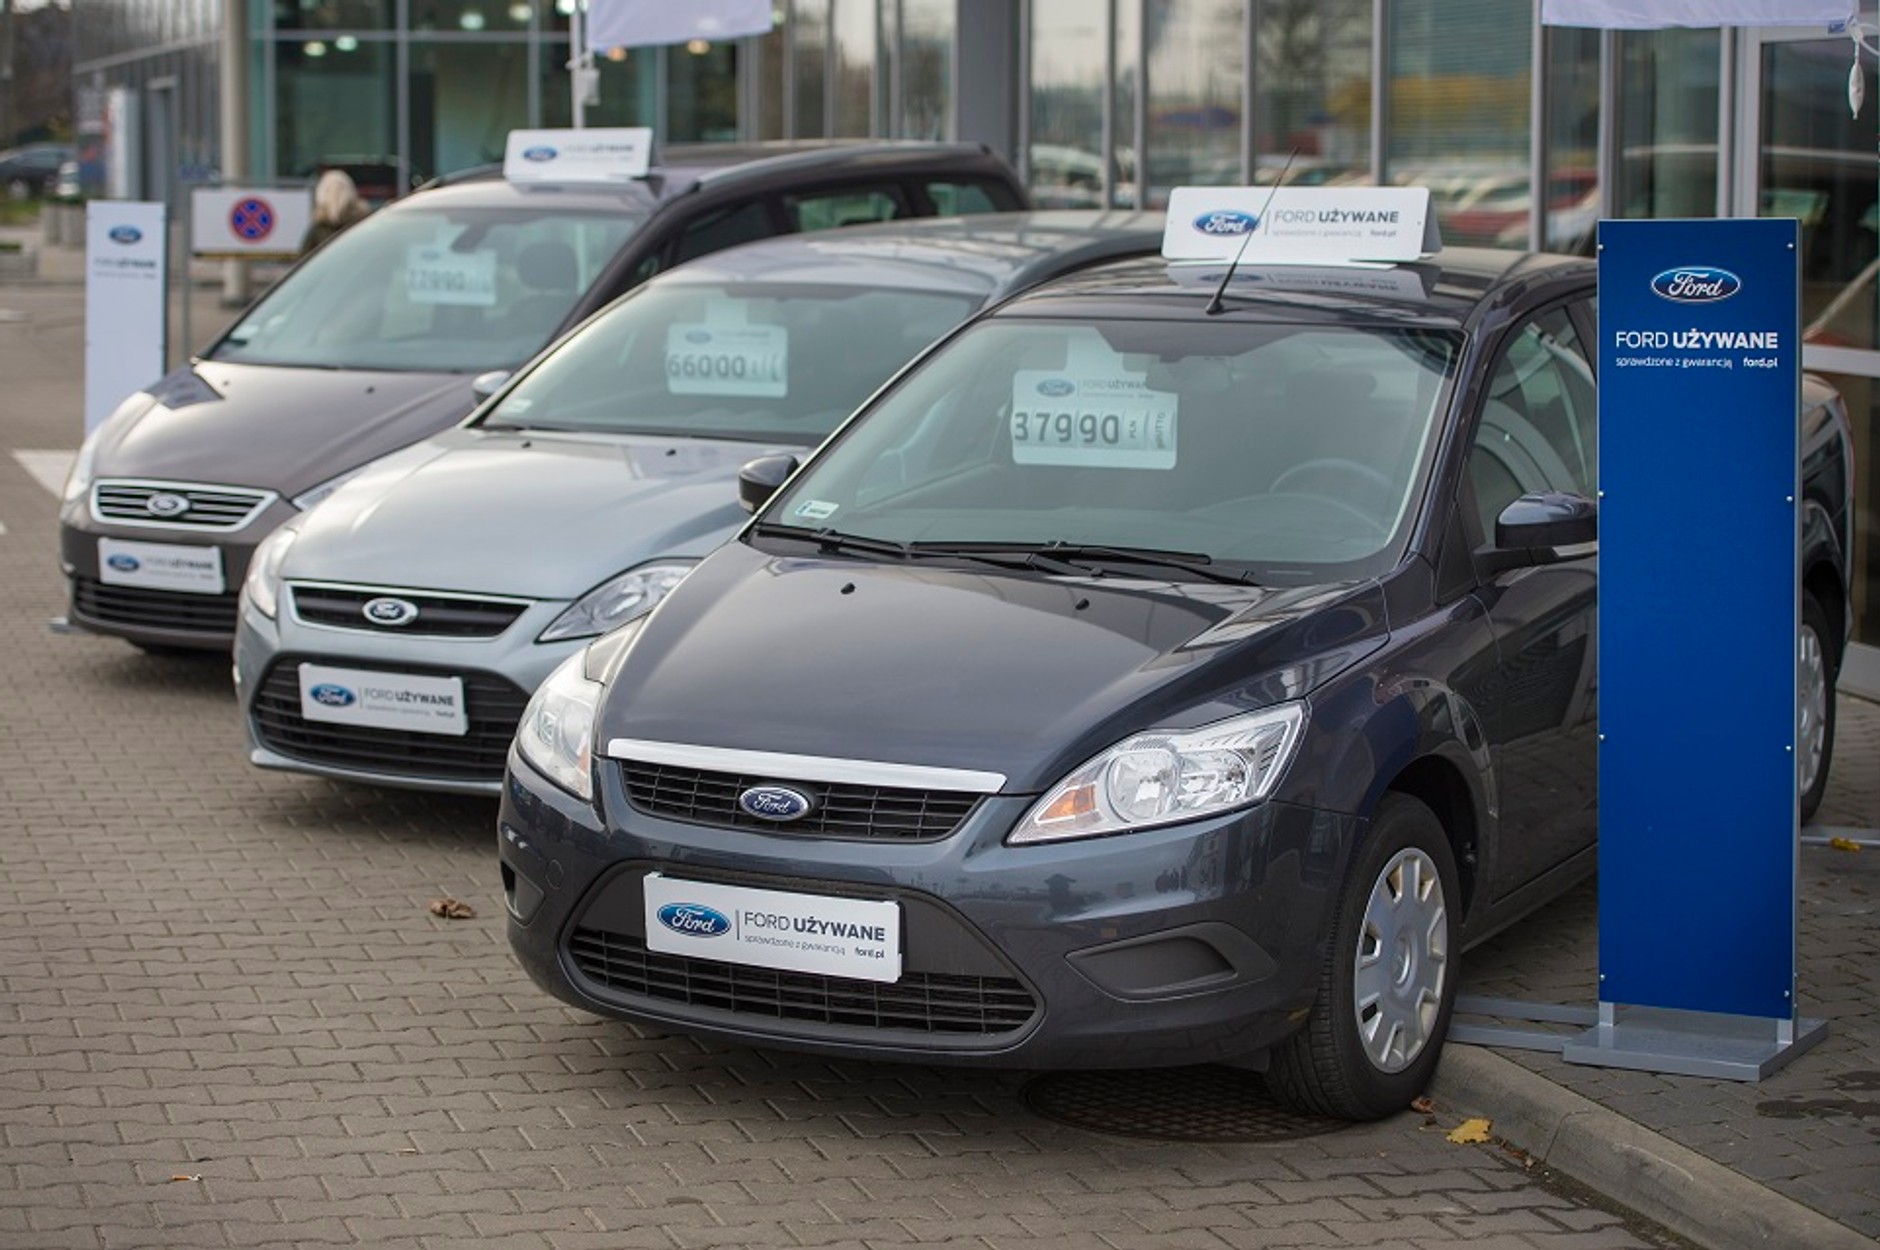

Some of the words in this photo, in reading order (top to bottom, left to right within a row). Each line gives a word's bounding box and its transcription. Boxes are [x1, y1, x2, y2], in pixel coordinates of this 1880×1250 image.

[1274, 210, 1316, 223] FORD
[1318, 208, 1399, 223] UŻYWANE
[1616, 331, 1669, 348] FORD
[1673, 328, 1778, 349] UŻYWANE
[668, 353, 746, 379] 66000
[1616, 355, 1674, 368] sprawdzone
[1743, 356, 1778, 368] ford.pl
[1014, 411, 1120, 444] 37990
[1128, 420, 1137, 439] PLN
[395, 689, 455, 707] UŻYWANE
[744, 911, 790, 931] FORD
[793, 916, 885, 942] UŻYWANE
[744, 934, 794, 949] sprawdzone
